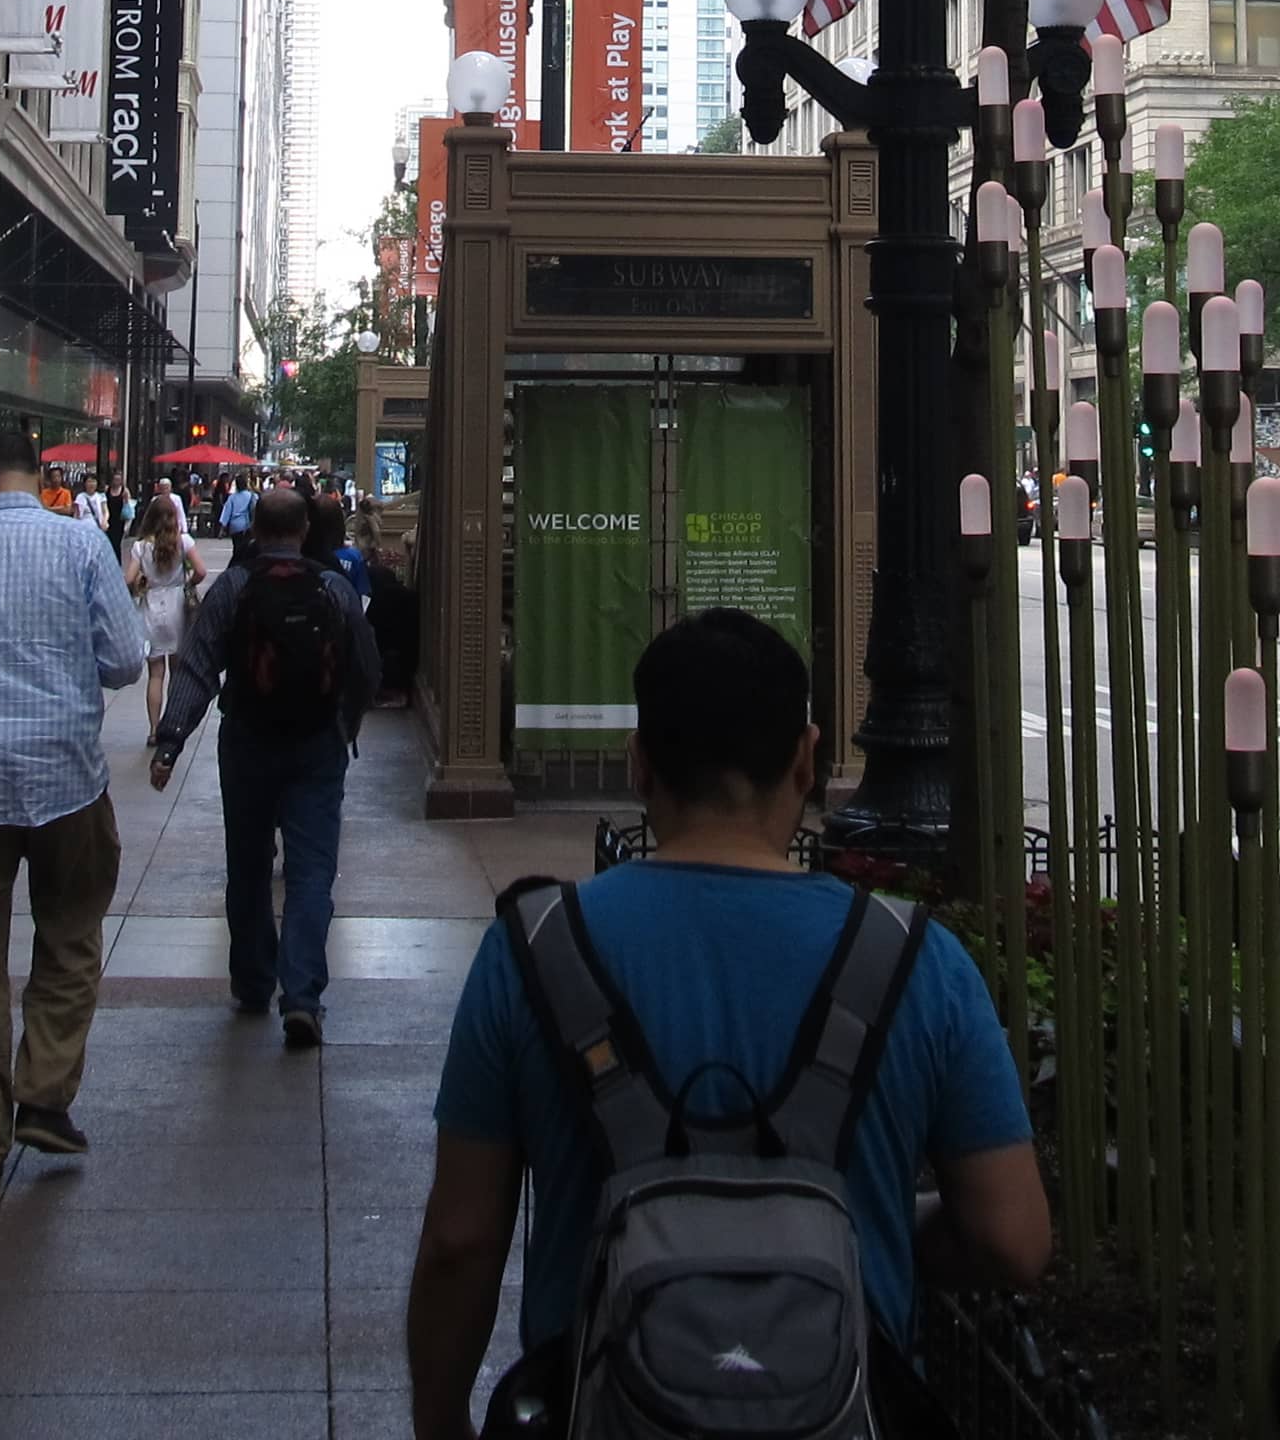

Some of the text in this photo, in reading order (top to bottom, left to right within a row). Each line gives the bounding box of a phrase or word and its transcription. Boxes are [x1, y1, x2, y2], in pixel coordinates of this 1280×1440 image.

[606, 12, 636, 69] Play
[608, 76, 630, 103] at
[111, 92, 148, 181] rack
[425, 200, 447, 274] Chicago
[614, 262, 722, 287] SUBWAY
[528, 513, 641, 530] WELCOME
[710, 512, 762, 521] CHICAGO
[710, 522, 761, 534] LOOP
[711, 535, 763, 543] ALLIANCE
